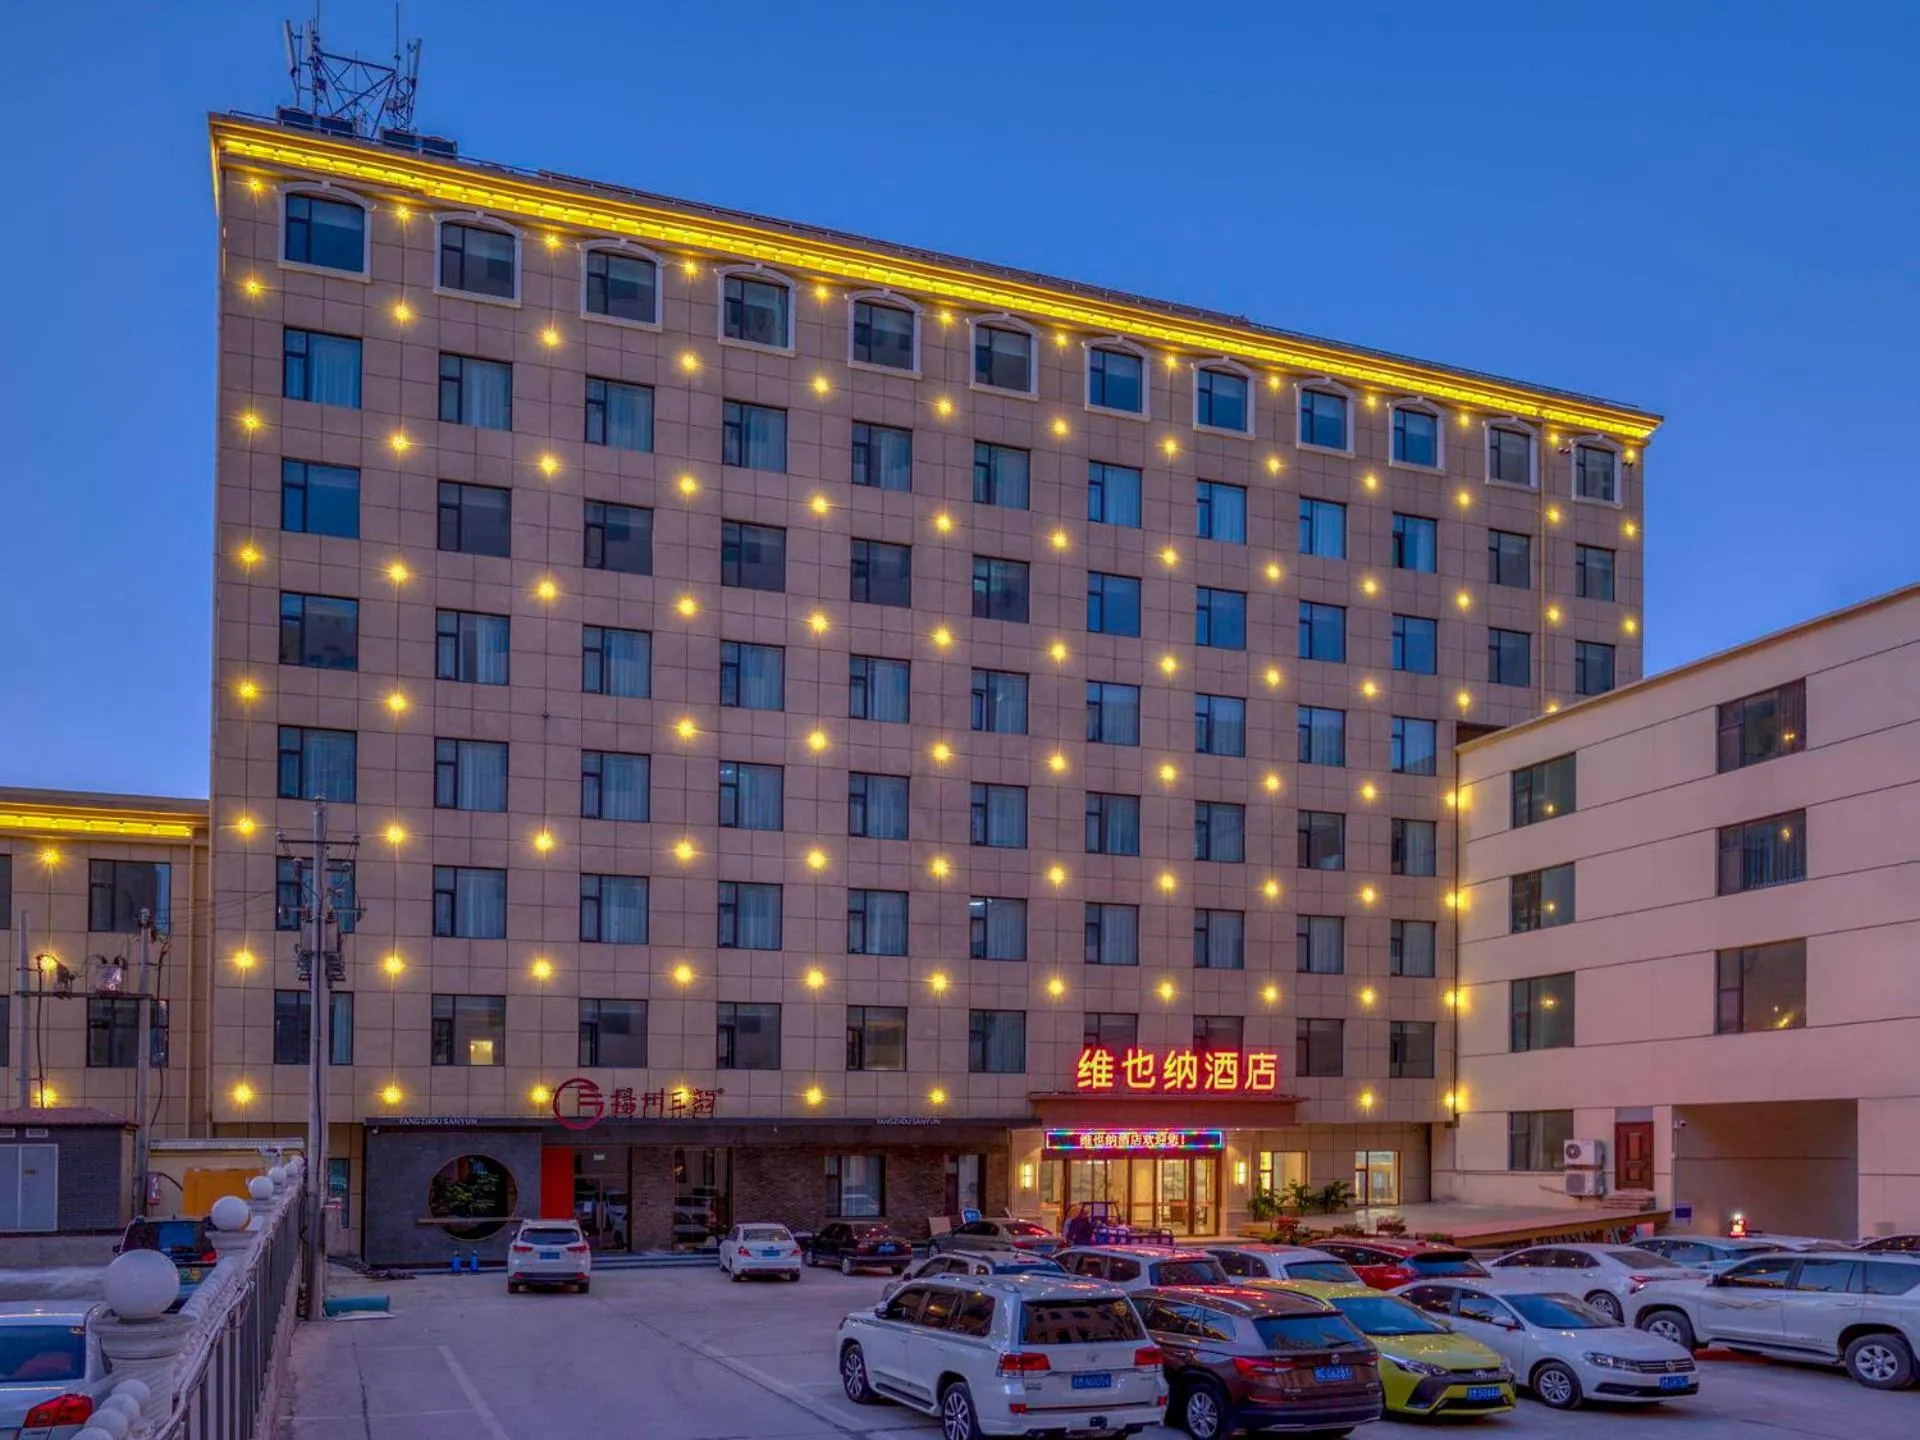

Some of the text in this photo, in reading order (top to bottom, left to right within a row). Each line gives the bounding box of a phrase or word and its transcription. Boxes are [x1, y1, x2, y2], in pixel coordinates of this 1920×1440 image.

[1076, 1048, 1278, 1091] 维也纳酒店
